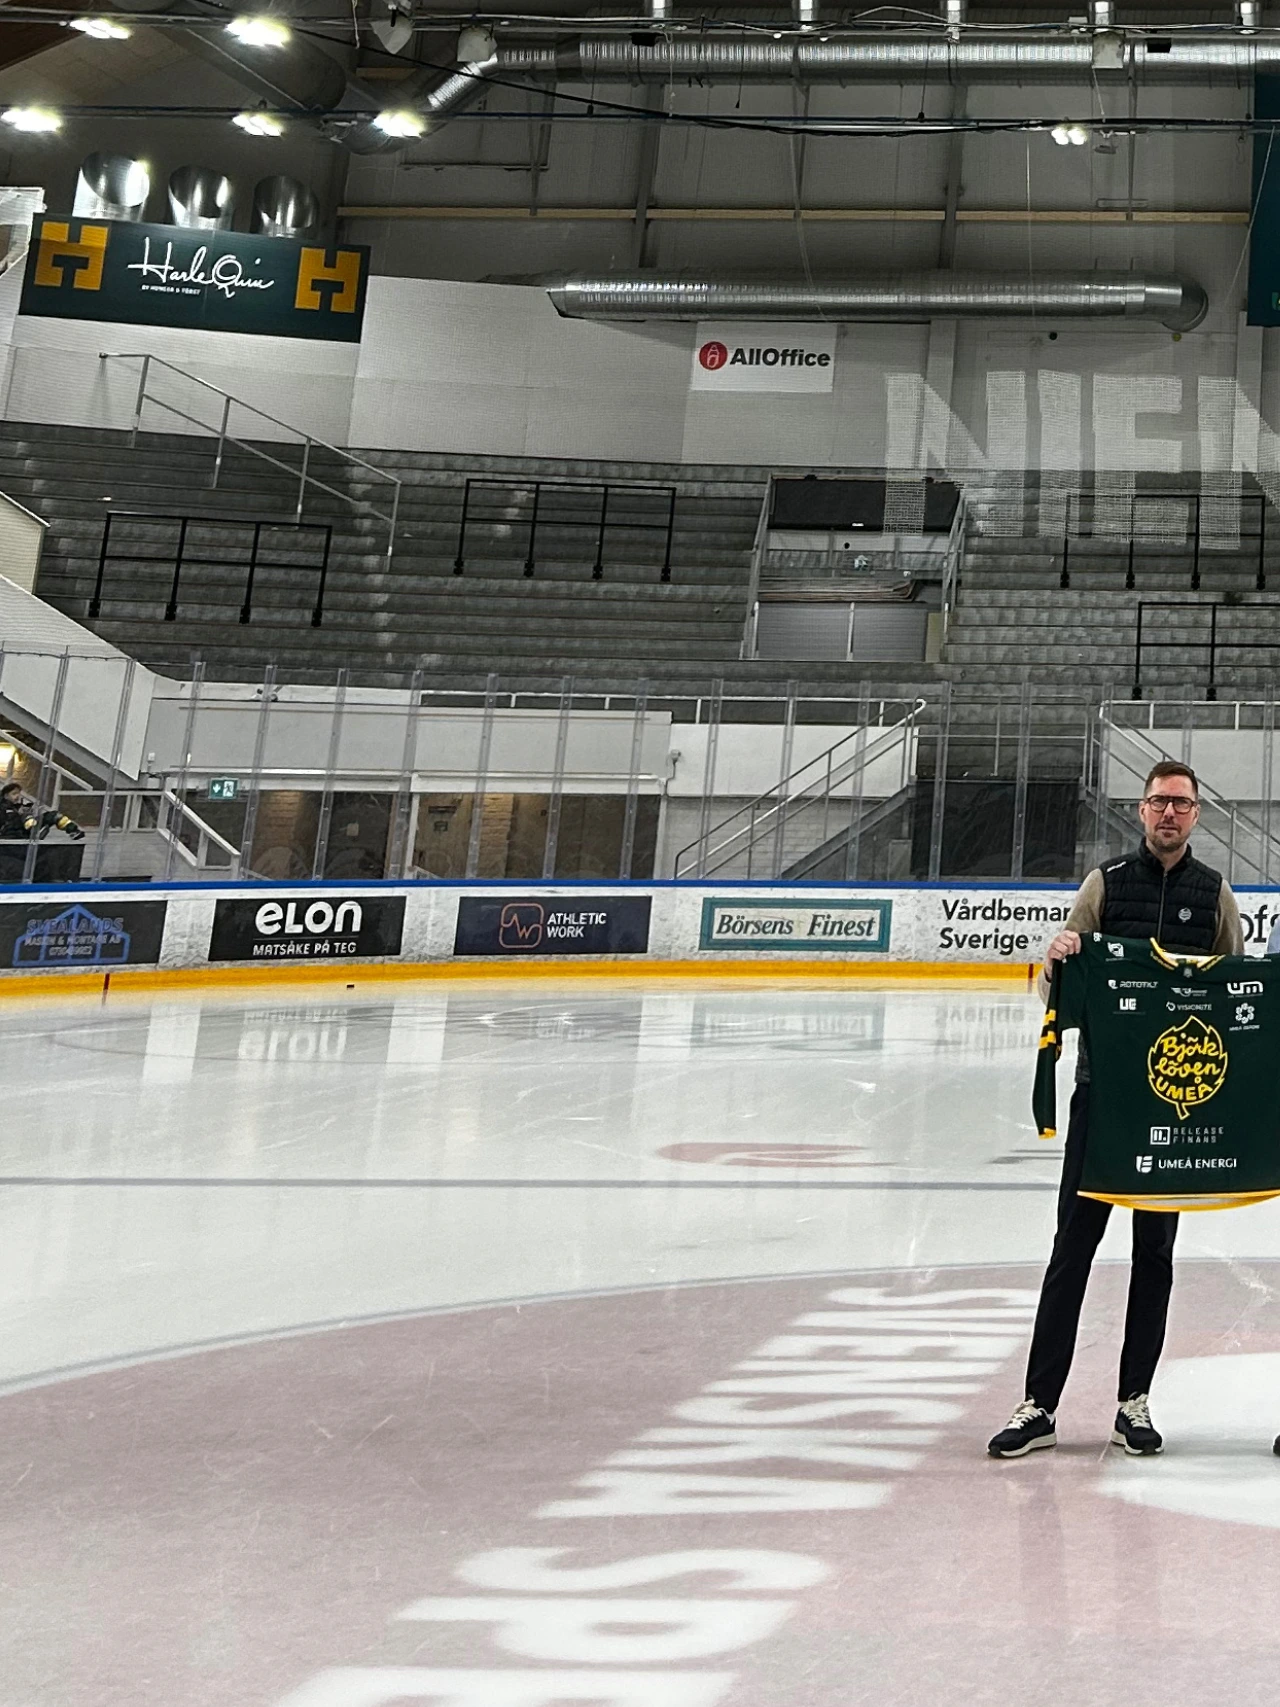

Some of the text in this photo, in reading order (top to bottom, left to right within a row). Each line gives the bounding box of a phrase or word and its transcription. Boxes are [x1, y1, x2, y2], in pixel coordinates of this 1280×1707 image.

[730, 347, 831, 367] AllOffice
[546, 912, 607, 925] ATHLETIC
[715, 913, 876, 937] Börsens Finest
[546, 926, 585, 939] WORK
[939, 927, 1029, 956] Sverige
[252, 939, 357, 956] MATSÅKE PÅ TEG
[1160, 1032, 1219, 1062] Björk
[1156, 1076, 1213, 1101] UMEÅ
[1158, 1156, 1237, 1169] UMEÅ ENERGI
